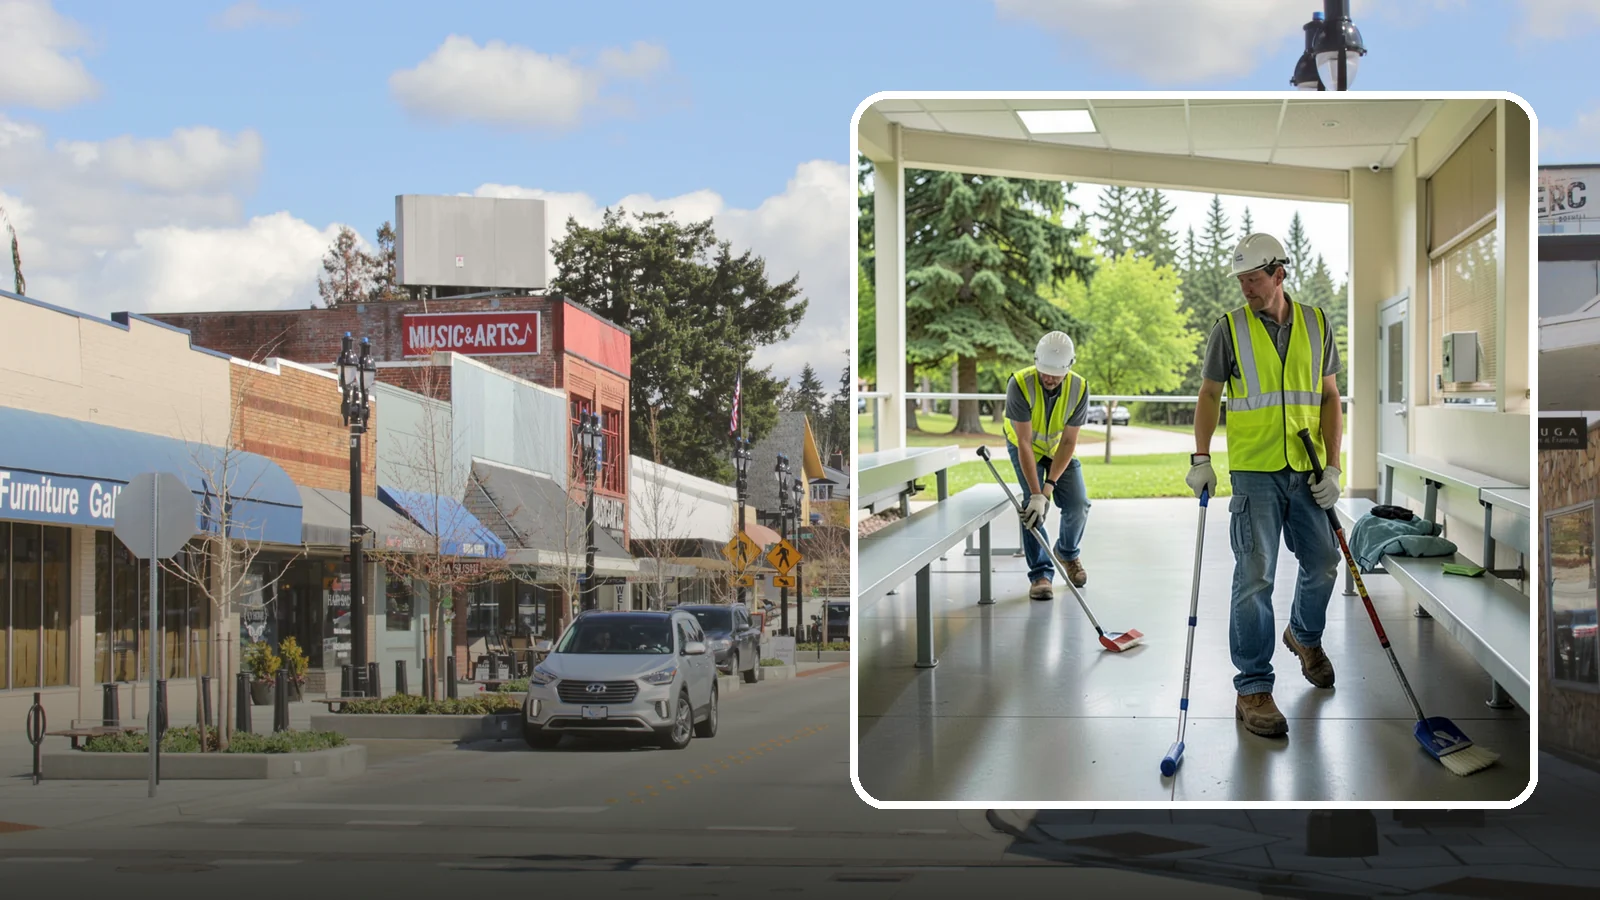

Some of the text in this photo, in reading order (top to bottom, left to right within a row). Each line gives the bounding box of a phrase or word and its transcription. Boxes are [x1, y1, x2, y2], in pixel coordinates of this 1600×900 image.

[408, 322, 519, 349] MUSIC&ARTS
[1540, 427, 1578, 437] UGA
[0, 471, 122, 519] Furniture Gal
